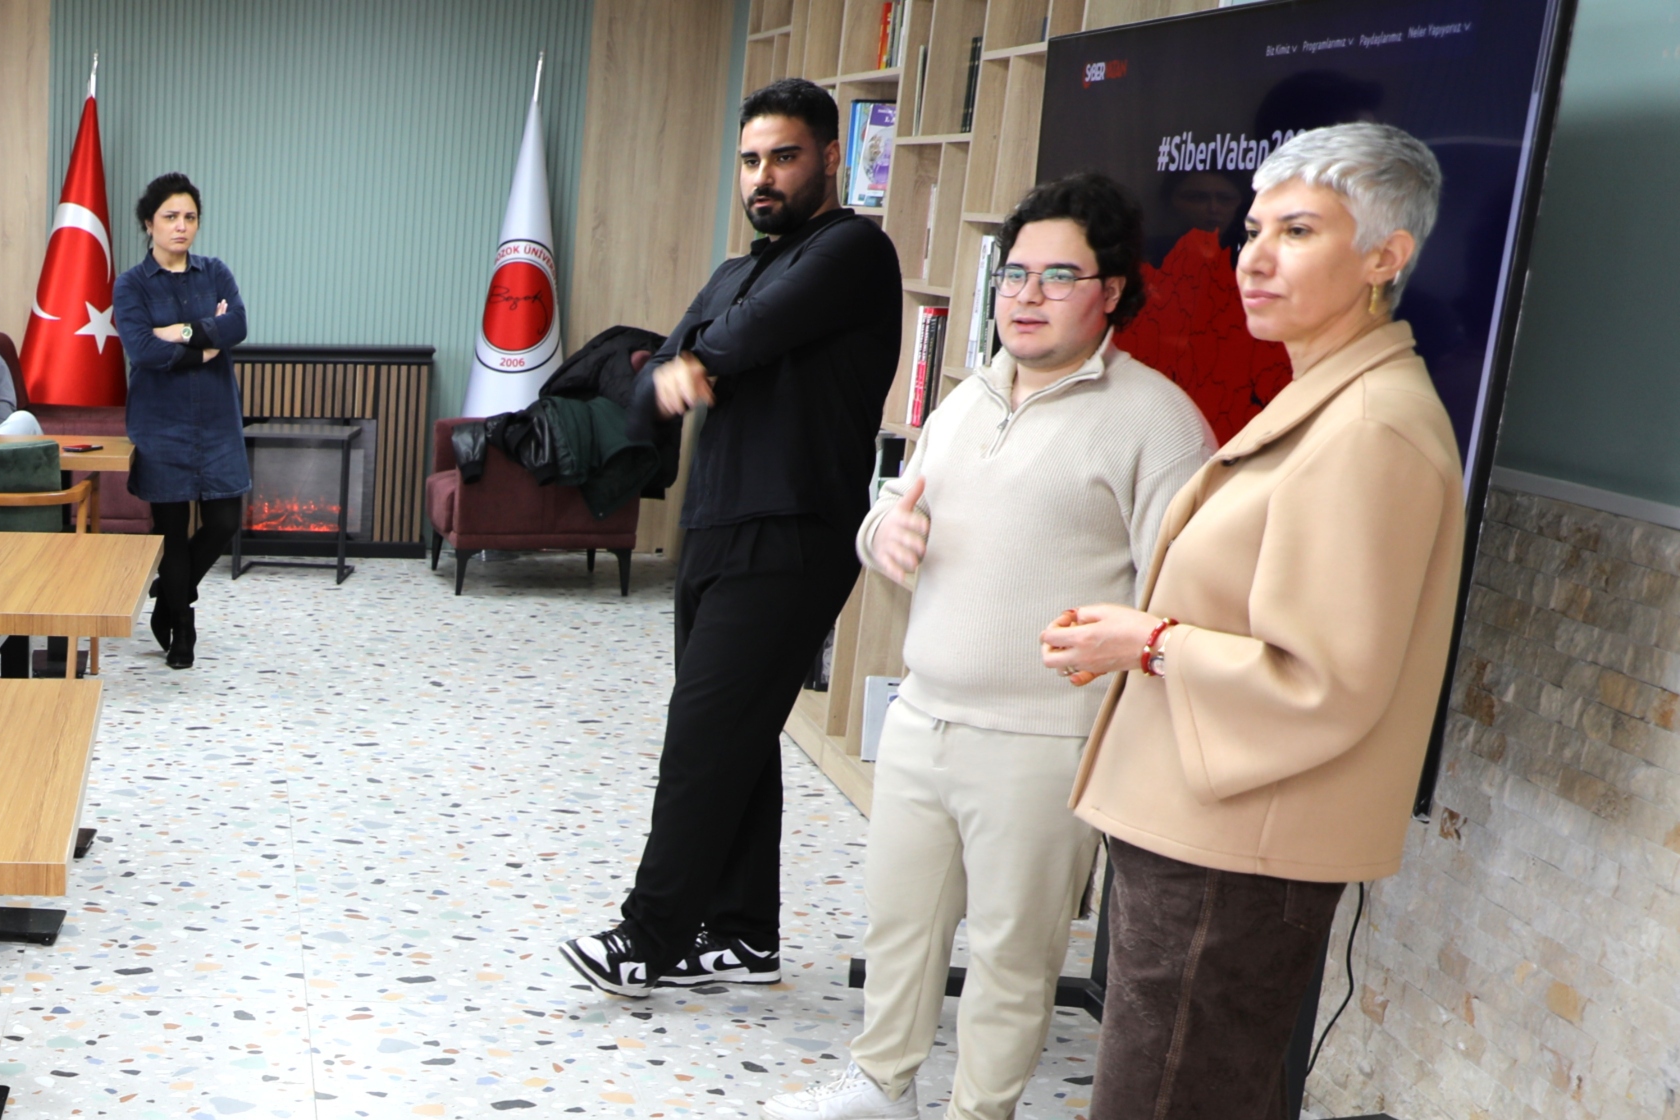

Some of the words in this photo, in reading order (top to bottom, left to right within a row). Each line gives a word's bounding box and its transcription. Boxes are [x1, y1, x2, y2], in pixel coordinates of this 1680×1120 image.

[1407, 24, 1427, 39] Neler
[1157, 130, 1270, 172] #SiberVatan
[499, 357, 526, 368] 2006
